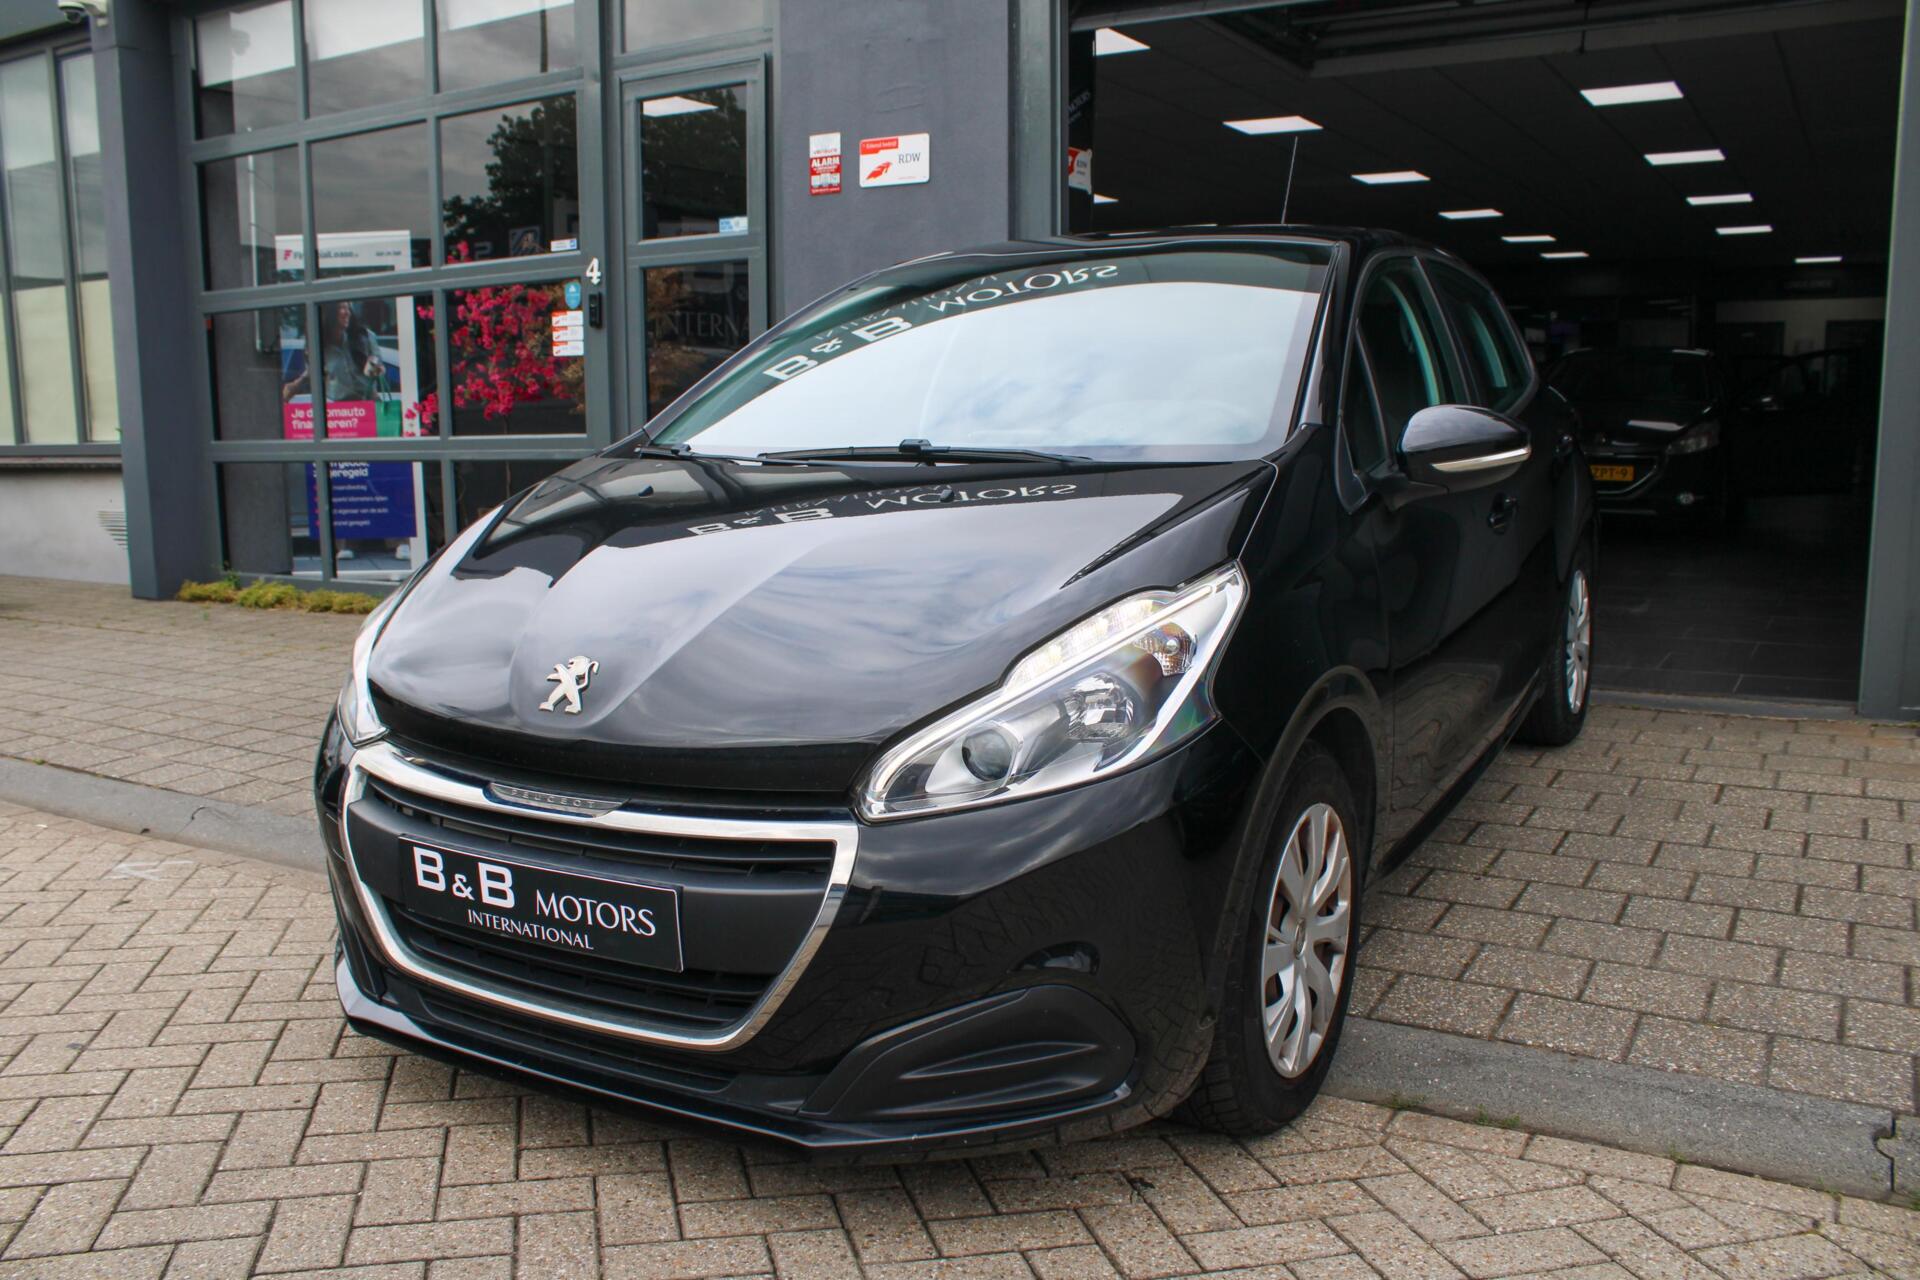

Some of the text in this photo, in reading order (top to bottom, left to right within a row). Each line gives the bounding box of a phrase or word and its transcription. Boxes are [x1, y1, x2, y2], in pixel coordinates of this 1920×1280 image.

[811, 156, 841, 168] ALARM
[898, 152, 921, 165] RDW
[585, 257, 602, 285] 4
[291, 408, 305, 419] Je
[510, 789, 597, 809] PEUGEOT
[535, 888, 657, 937] MOTORS
[467, 908, 596, 951] INTERNATIONAL
